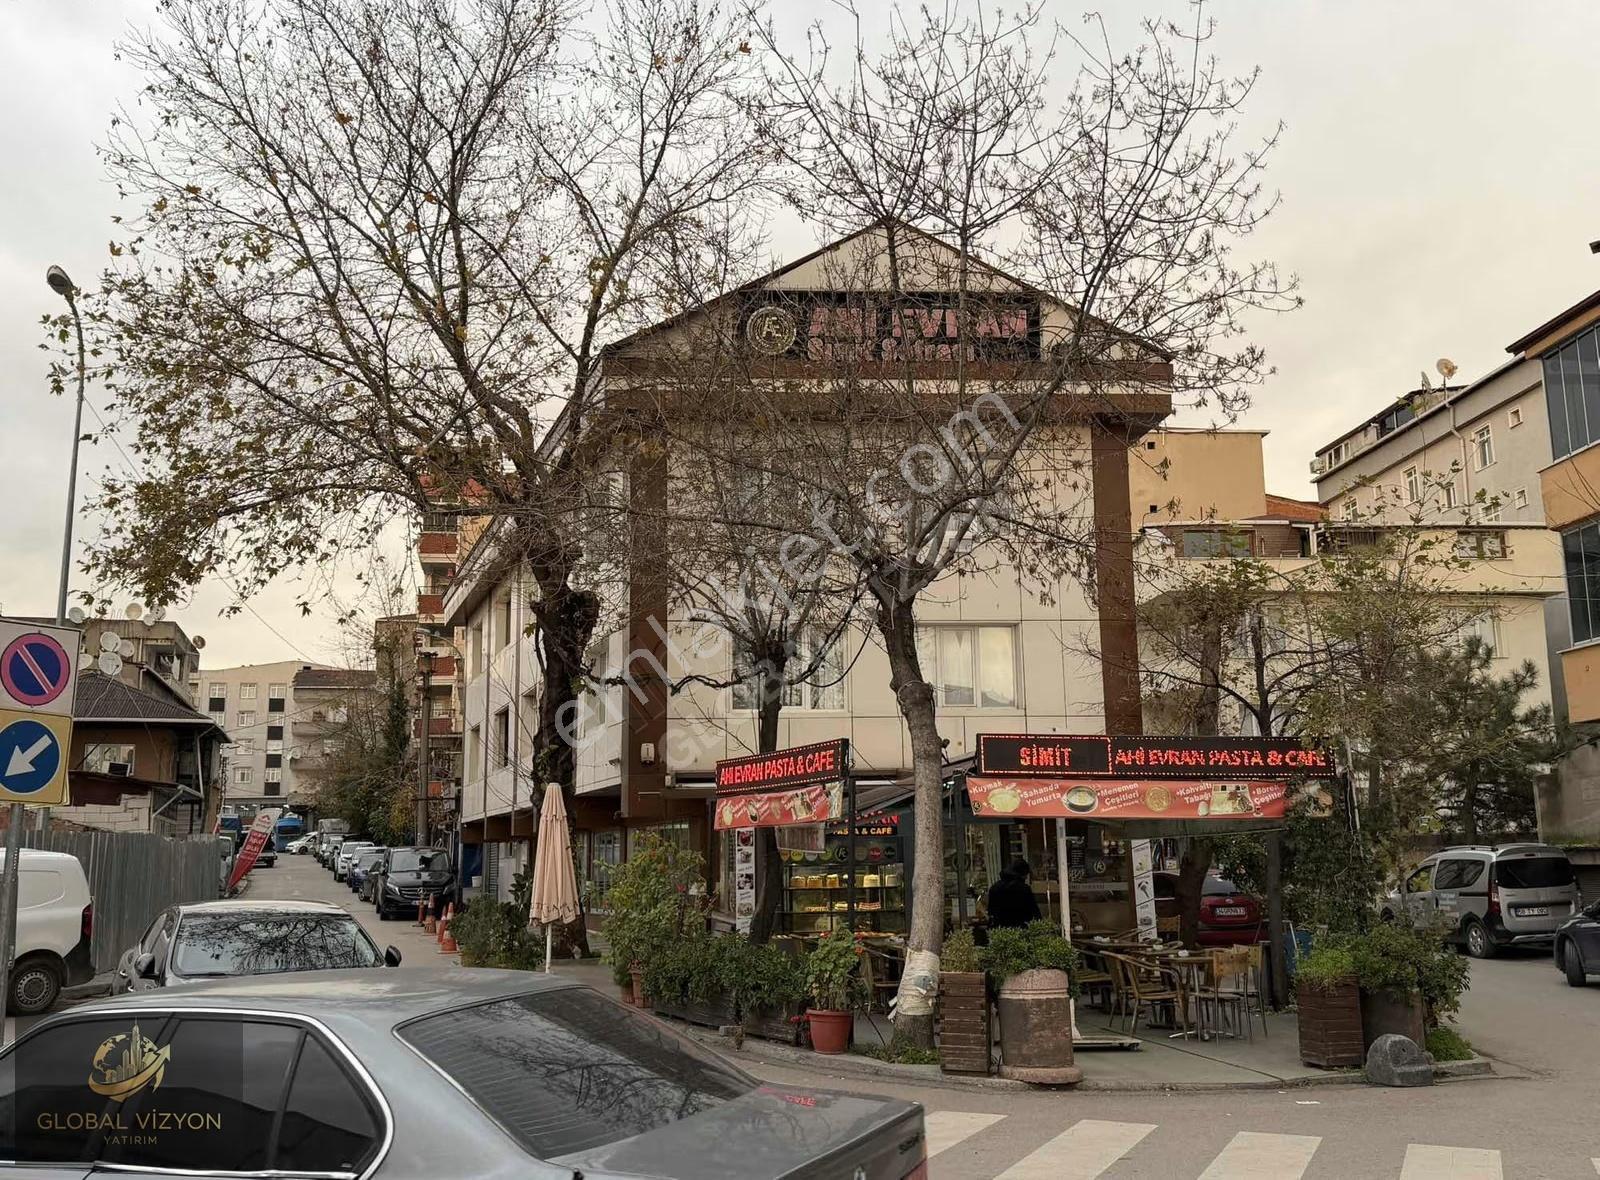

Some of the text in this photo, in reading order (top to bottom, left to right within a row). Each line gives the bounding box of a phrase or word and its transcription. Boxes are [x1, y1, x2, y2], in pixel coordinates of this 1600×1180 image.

[1019, 744, 1072, 767] SİMİT
[1148, 749, 1206, 766] EVRAN
[1208, 749, 1265, 767] PASTA
[1266, 750, 1283, 766] &
[764, 756, 796, 780] PASTA
[796, 755, 805, 774] &
[805, 750, 835, 774] CAFE
[973, 780, 1003, 795] Kuymak
[1023, 783, 1060, 798] Sahanda
[1100, 783, 1139, 797] Menemen
[1026, 792, 1061, 807] Yumurta
[861, 827, 868, 835] &
[870, 827, 893, 835] CAFE
